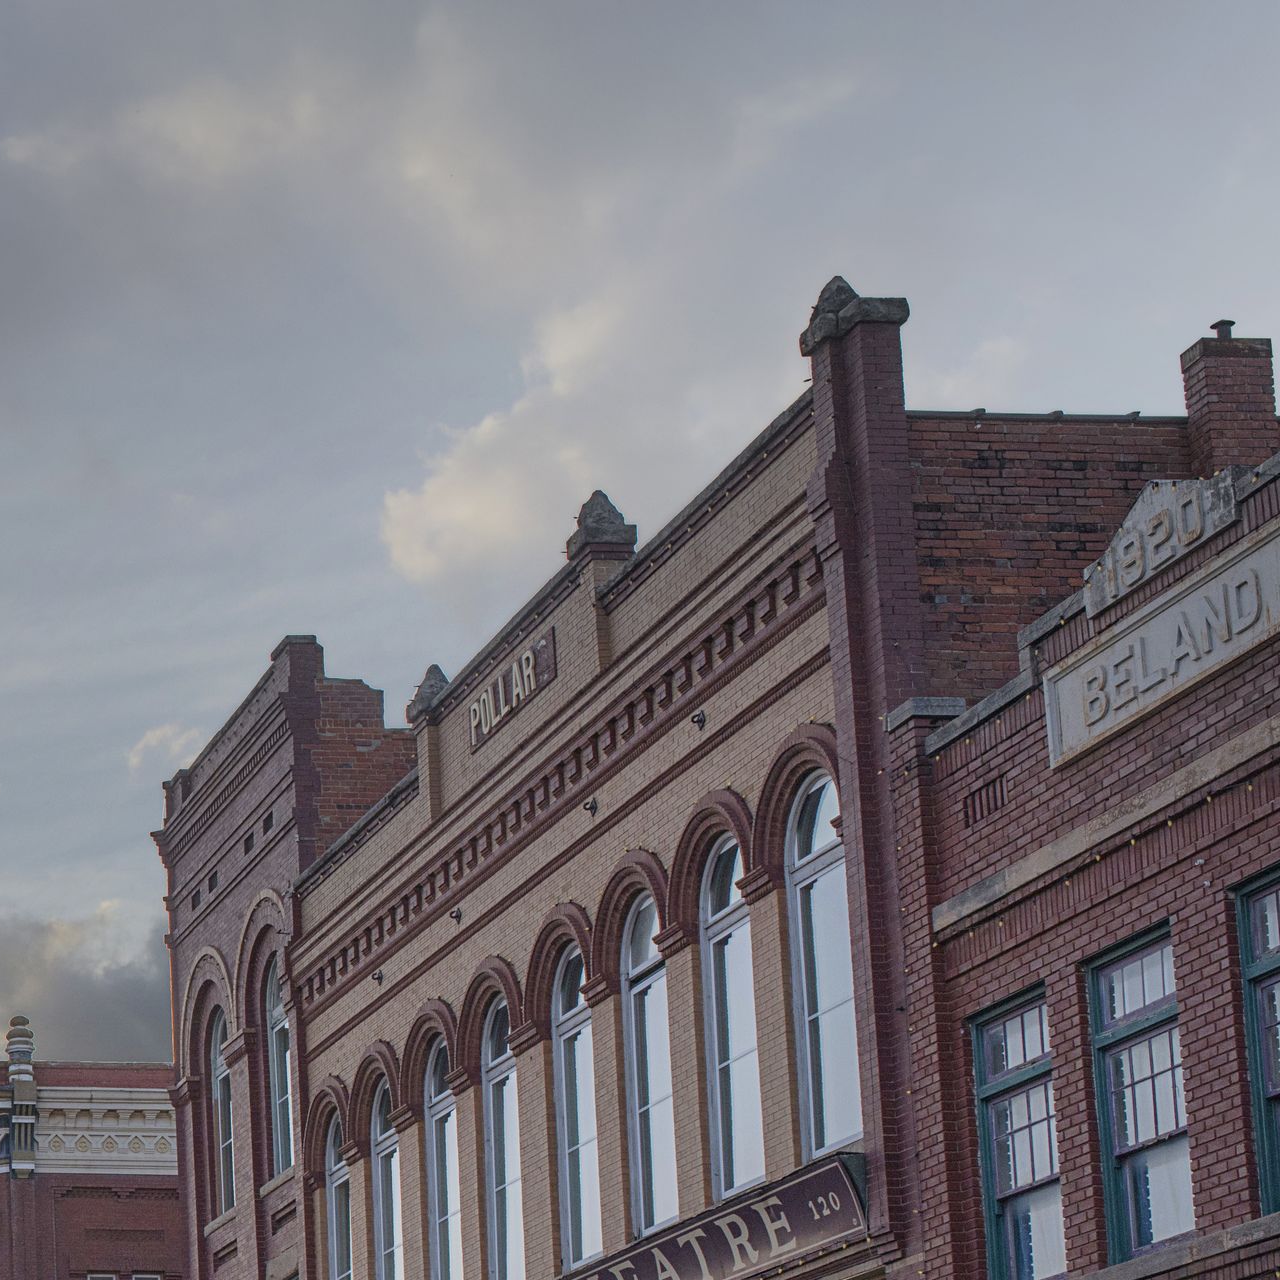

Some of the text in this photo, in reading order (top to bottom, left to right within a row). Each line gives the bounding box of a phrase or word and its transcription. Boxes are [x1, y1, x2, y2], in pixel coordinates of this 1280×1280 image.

[1107, 488, 1204, 599] 1920
[1083, 568, 1263, 727] BELAND
[807, 1191, 842, 1221] 120
